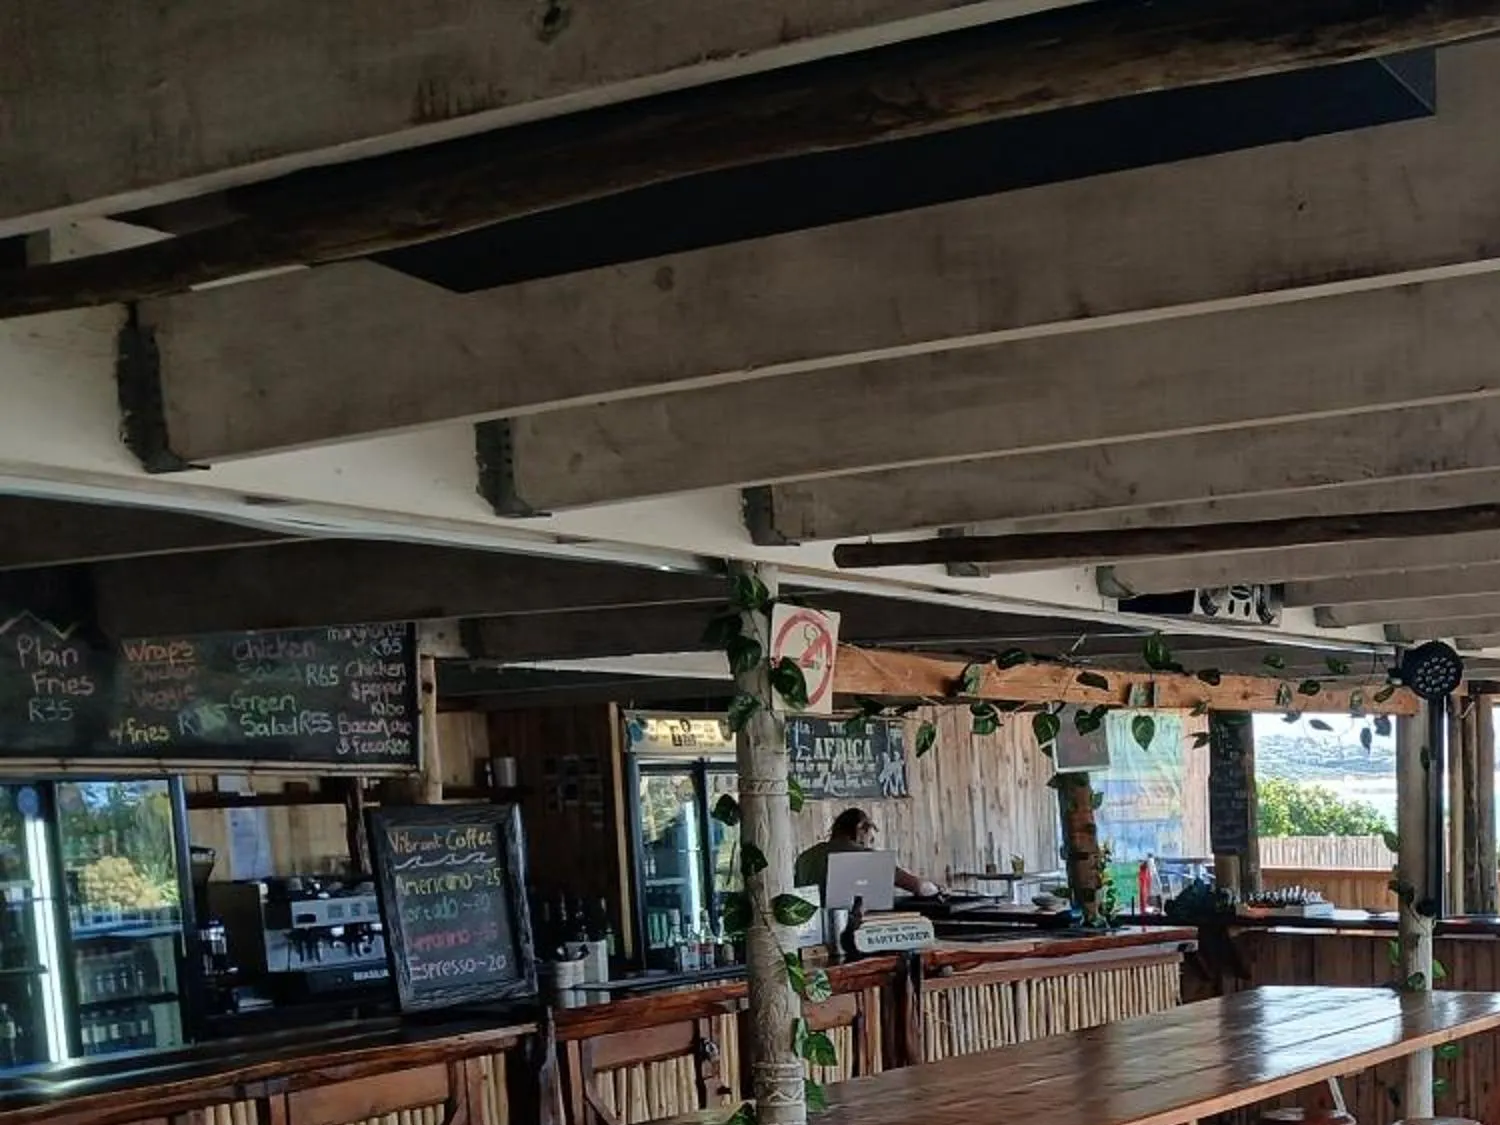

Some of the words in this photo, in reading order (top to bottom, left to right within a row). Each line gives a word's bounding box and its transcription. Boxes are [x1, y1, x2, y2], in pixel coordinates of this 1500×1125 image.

[17, 634, 79, 668] Plain
[121, 639, 196, 665] Wraps
[231, 635, 318, 662] Chicken
[32, 669, 95, 696] Fries
[306, 662, 340, 687] R65
[28, 698, 75, 723] R35
[230, 690, 297, 715] Green
[240, 713, 301, 738] Salad
[813, 737, 875, 763] AFRICA
[387, 830, 444, 854] Vibrant
[445, 827, 493, 850] Coffee
[408, 955, 478, 982] Espresso
